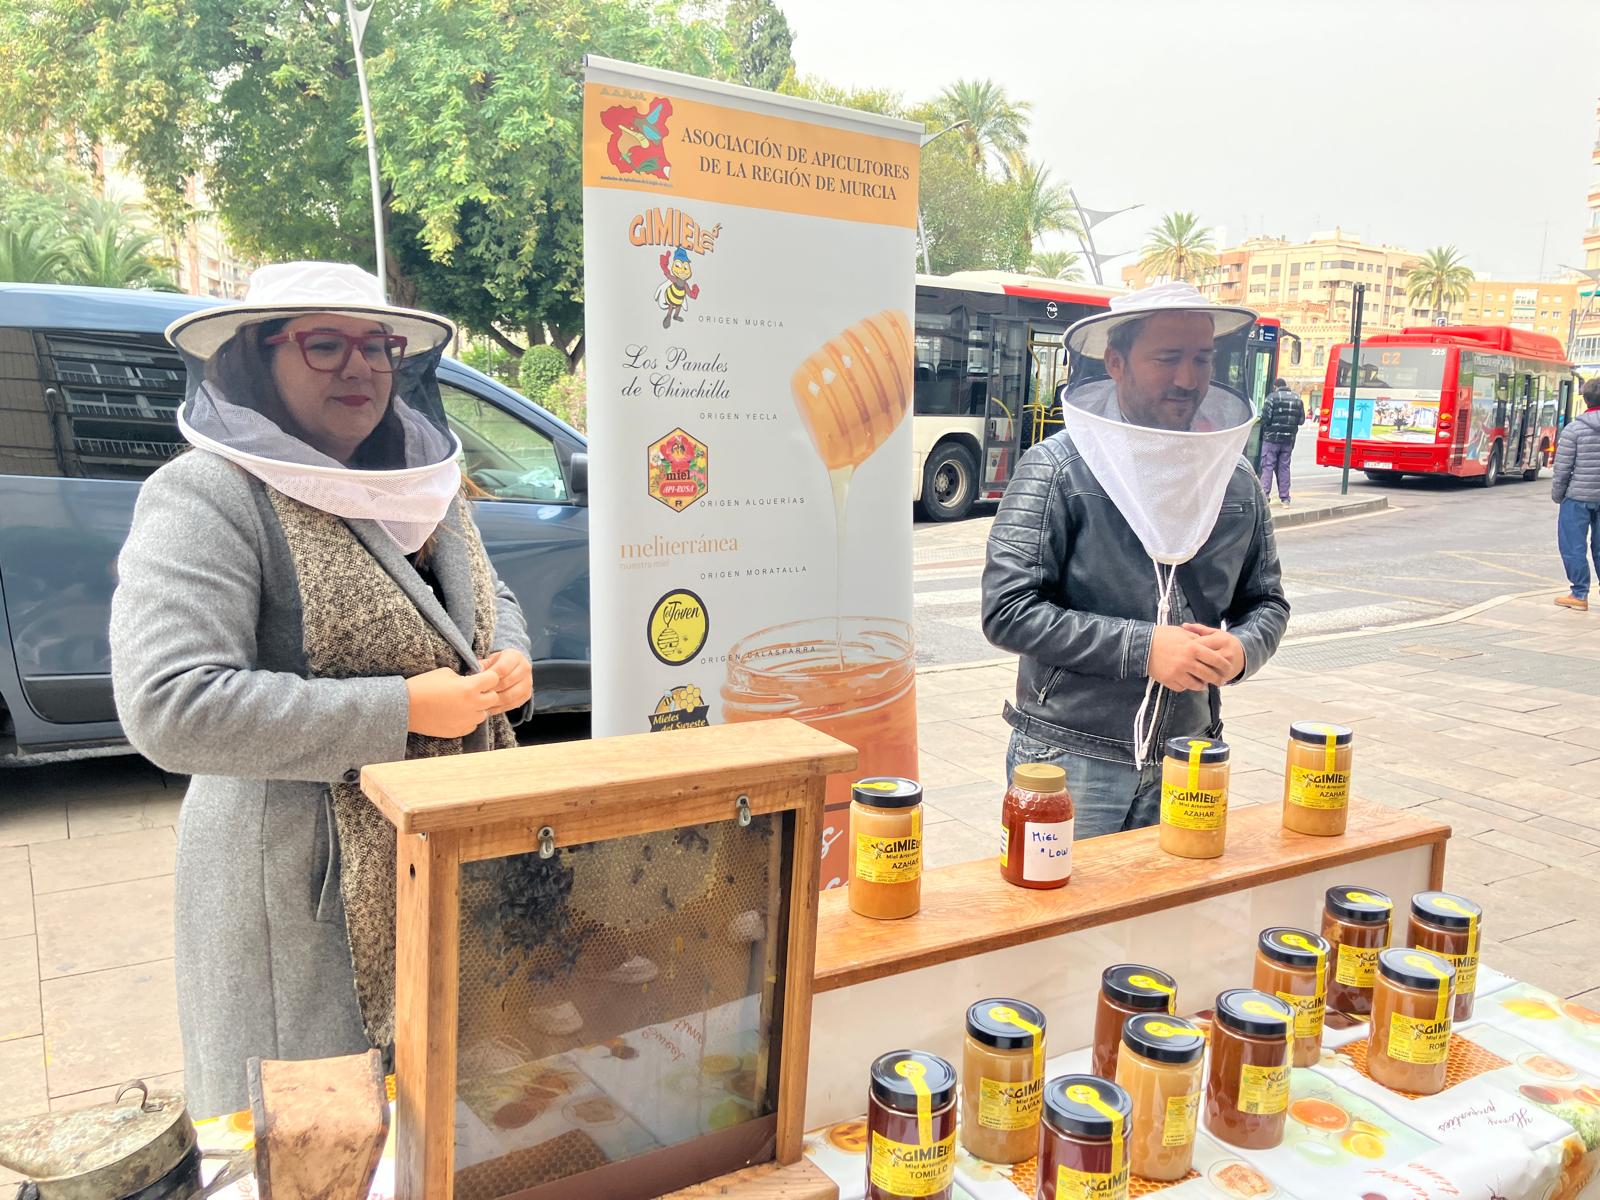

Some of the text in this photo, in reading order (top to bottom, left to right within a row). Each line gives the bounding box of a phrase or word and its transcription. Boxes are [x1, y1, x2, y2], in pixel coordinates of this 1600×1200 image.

[681, 127, 909, 180] ASOCIACIÓN DE APICULTORES
[700, 156, 896, 201] DE LA REGIÓN DE MURCIA
[698, 315, 784, 328] ORIGEN MURCIA
[622, 344, 728, 373] Los Panales
[621, 373, 731, 400] de Chinchilla
[699, 412, 778, 421] ORIGEN YECLA
[666, 469, 690, 481] miel
[700, 496, 805, 508] ORIGEN ALQUERÍAS
[620, 534, 738, 560] meliterránea
[700, 566, 807, 580] ORIGEN MORATALLA
[700, 645, 816, 665] ORIGEN CALASPARRA
[653, 713, 679, 725] Mieles
[1183, 810, 1215, 818] AZAHAR
[910, 1164, 948, 1179] TOMILLO
